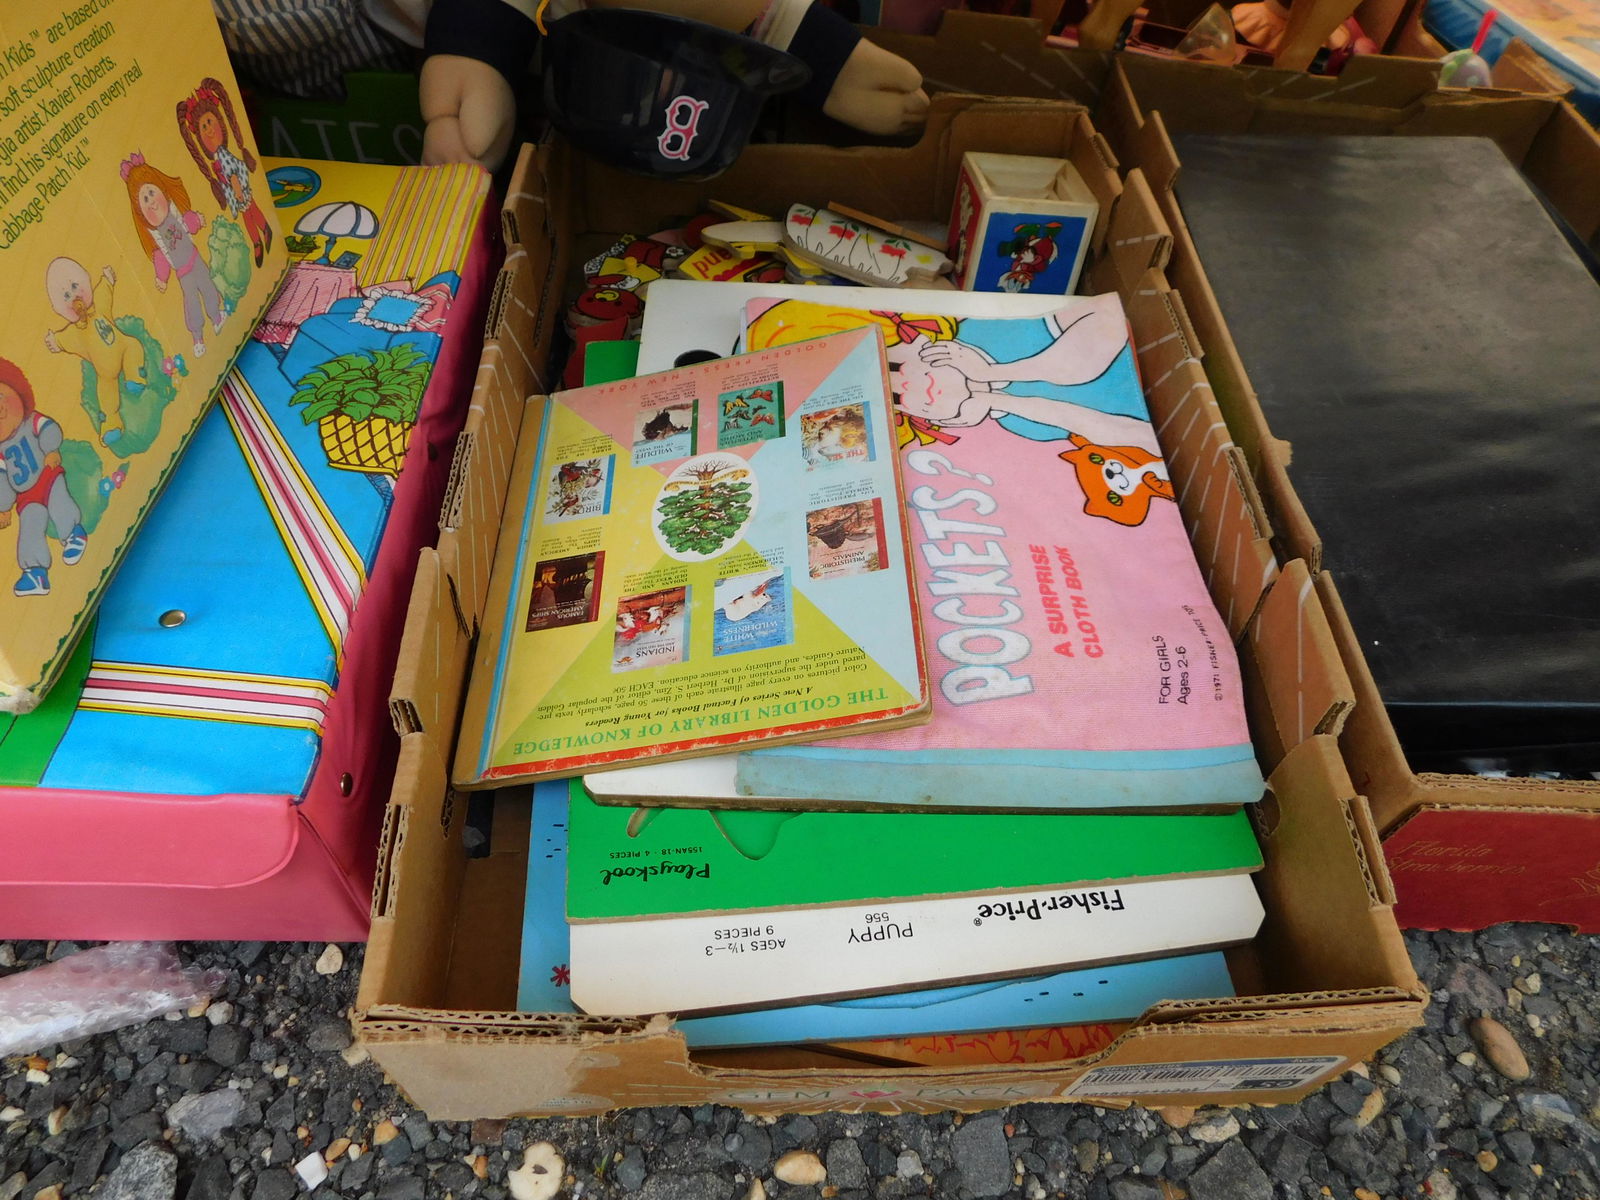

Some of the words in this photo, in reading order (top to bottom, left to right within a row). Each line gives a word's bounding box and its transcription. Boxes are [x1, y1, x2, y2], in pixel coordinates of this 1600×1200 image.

[46, 22, 66, 43] are
[0, 85, 24, 117] soft
[21, 52, 73, 99] sculpture
[73, 21, 116, 59] creation
[14, 110, 46, 144] artist
[37, 86, 76, 122] Xavier
[71, 56, 116, 94] Roberts.
[0, 162, 29, 197] find
[20, 153, 45, 176] his
[41, 112, 89, 160] signature
[86, 100, 103, 119] on
[100, 77, 127, 107] every
[123, 58, 143, 86] real
[657, 95, 709, 161] B
[36, 166, 72, 204] Patch
[4, 436, 38, 487] 31
[832, 550, 864, 560] ANIMALS
[819, 555, 864, 569] PREHISTORIC
[1054, 545, 1084, 591] BOOK
[1029, 543, 1068, 635] SURPRISE
[723, 619, 777, 635] WILDERNESS
[1068, 596, 1104, 659] CLOTH
[723, 632, 753, 642] WHITE
[635, 644, 674, 658] INDIANS
[802, 649, 833, 663] Guides,
[835, 645, 864, 657] Nature
[1053, 641, 1075, 658] A
[1152, 635, 1171, 672] GIRLS
[784, 656, 799, 666] and
[815, 658, 838, 669] under
[841, 651, 865, 664] pared
[1175, 646, 1189, 668] 2-6
[732, 665, 741, 673] on
[744, 657, 781, 672] authority
[798, 663, 811, 672] the
[843, 662, 866, 673] Color
[700, 668, 728, 679] science
[737, 674, 745, 682] of
[749, 663, 795, 680] supervision
[774, 673, 790, 683] every
[807, 664, 840, 679] pictures
[628, 680, 653, 691] EACH
[656, 673, 697, 687] education.
[686, 678, 717, 691] Herbert
[720, 676, 733, 685] Dr.
[746, 677, 764, 687] page
[627, 689, 650, 700] editor
[653, 685, 672, 696] Zim,
[675, 684, 682, 692] S.
[686, 689, 703, 699] each
[706, 682, 742, 697] illustrate
[782, 687, 801, 698] New
[806, 685, 812, 693] A
[1159, 676, 1171, 704] FOR
[1177, 671, 1191, 705] Ages
[567, 695, 597, 709] popular
[600, 695, 612, 704] the
[615, 694, 624, 702] of
[651, 694, 671, 704] these
[674, 693, 681, 701] of
[739, 694, 749, 705] of
[752, 691, 780, 703] Series
[847, 686, 887, 705] THE
[536, 702, 565, 714] Golden
[575, 702, 611, 716] scholarly
[671, 703, 700, 715] Books
[703, 698, 736, 710] Factual
[757, 693, 840, 720] GOLDEN
[536, 711, 552, 721] pre-
[554, 709, 573, 719] texts
[623, 710, 651, 723] Young
[654, 707, 667, 718] for
[584, 715, 620, 729] Readers
[669, 708, 749, 733] LIBRARY
[636, 722, 662, 738] OF
[511, 724, 631, 758] KNOWLEDGE
[609, 850, 641, 859] PIECES
[600, 860, 710, 885] Playskool
[865, 911, 890, 923] 556
[713, 926, 761, 940] PIECES
[765, 924, 774, 935] 9
[847, 921, 914, 944] PUPPY
[751, 937, 786, 951] AGES
[916, 1086, 1027, 1098] PACK
